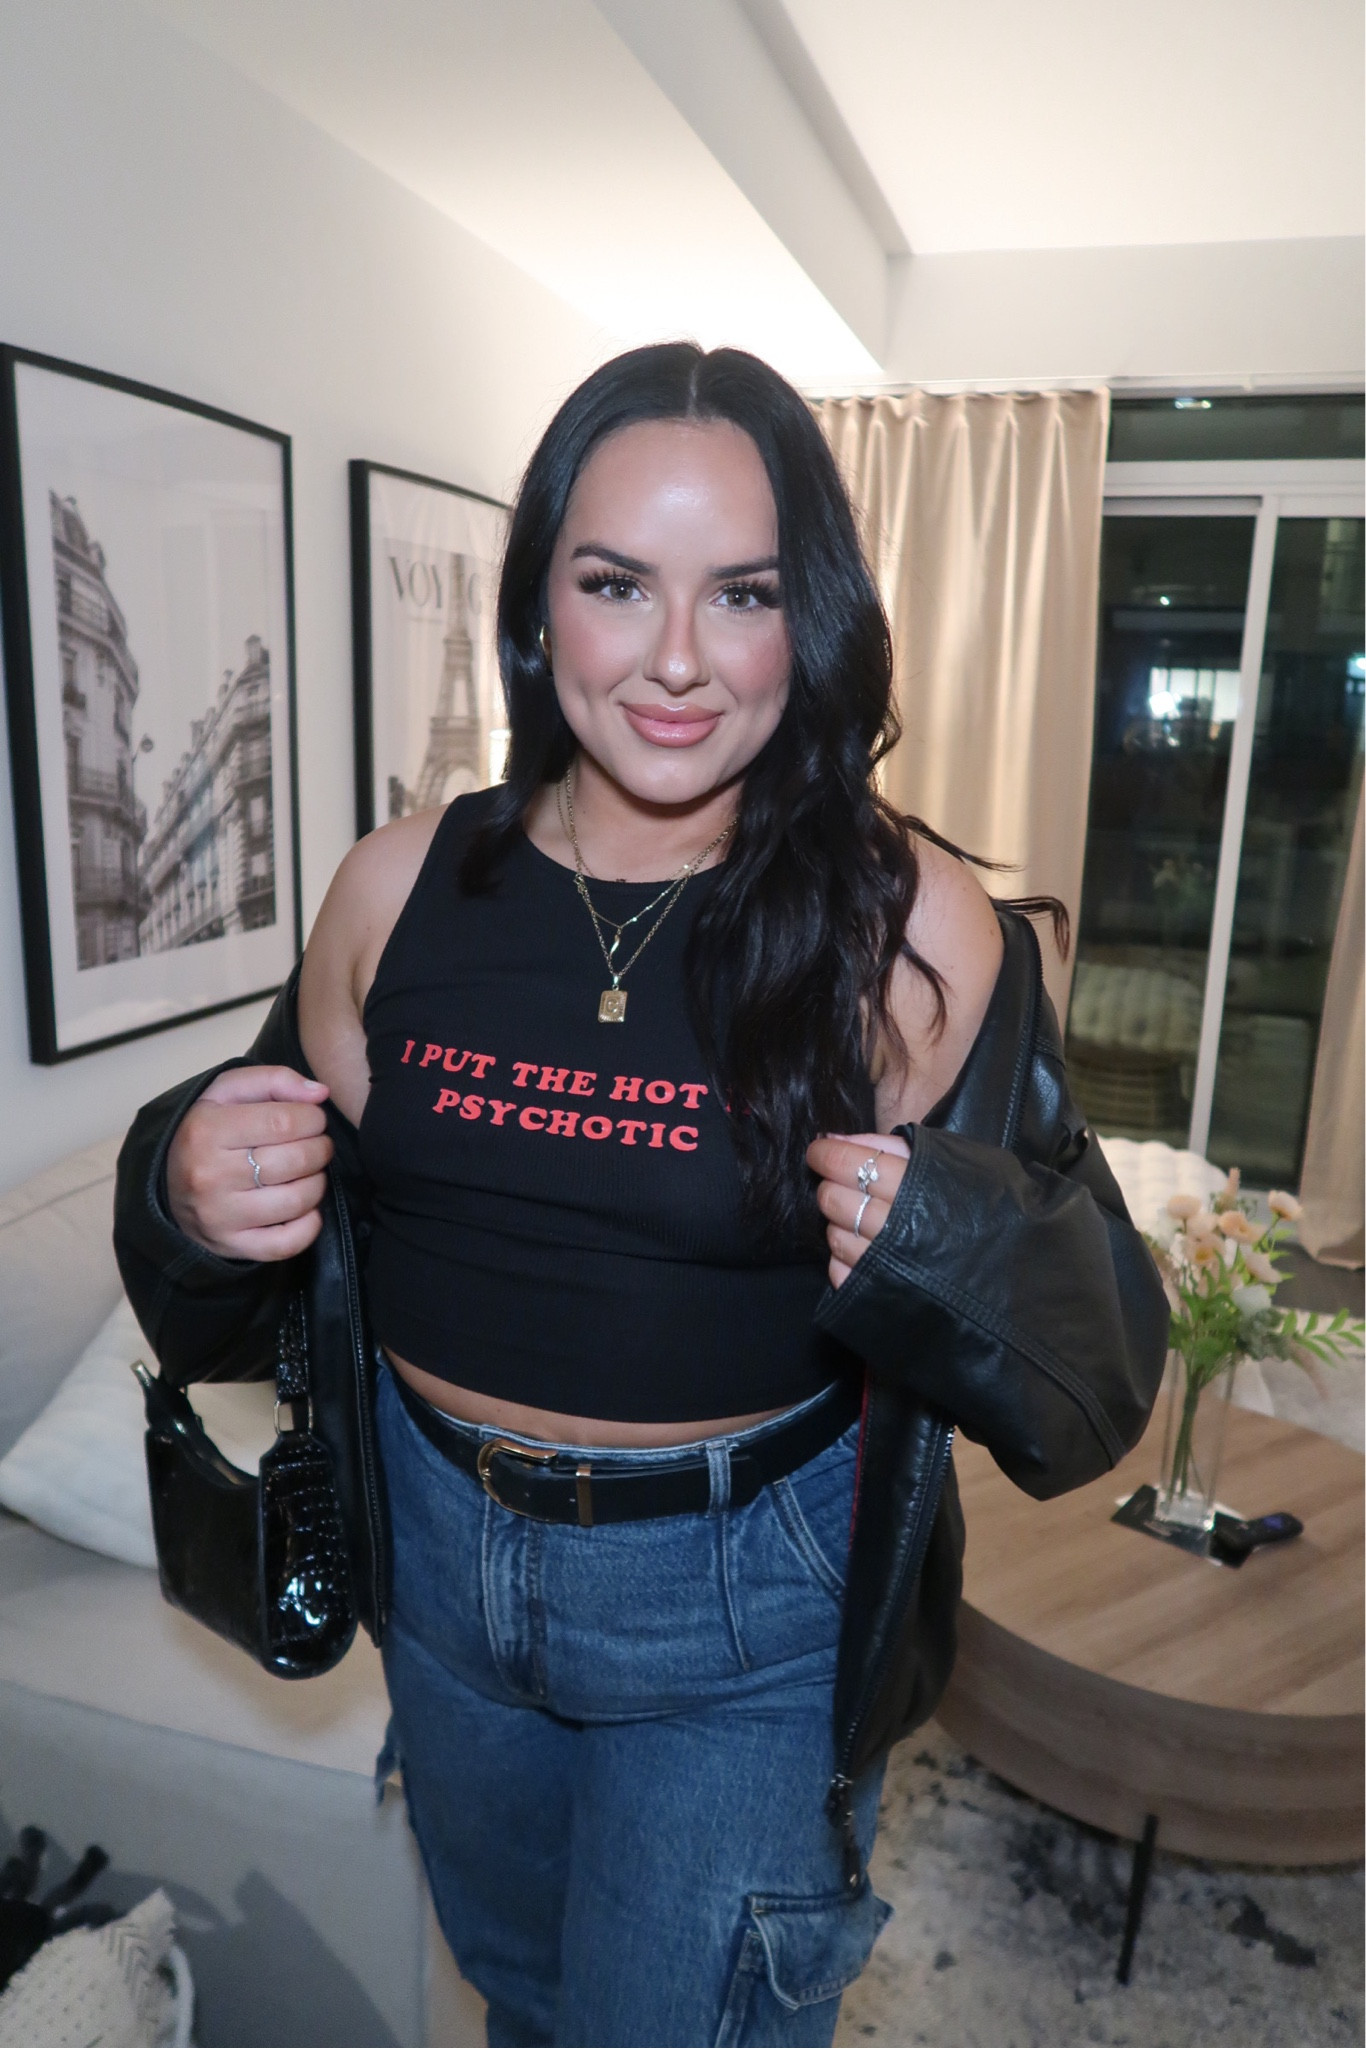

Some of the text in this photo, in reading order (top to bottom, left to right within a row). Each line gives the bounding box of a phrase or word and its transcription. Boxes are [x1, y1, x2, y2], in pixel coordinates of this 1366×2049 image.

[401, 1039, 415, 1064] I
[419, 1043, 496, 1079] PUT
[512, 1061, 597, 1097] THE
[609, 1075, 709, 1110] HOT
[433, 1088, 699, 1152] PSYCHOTIC
